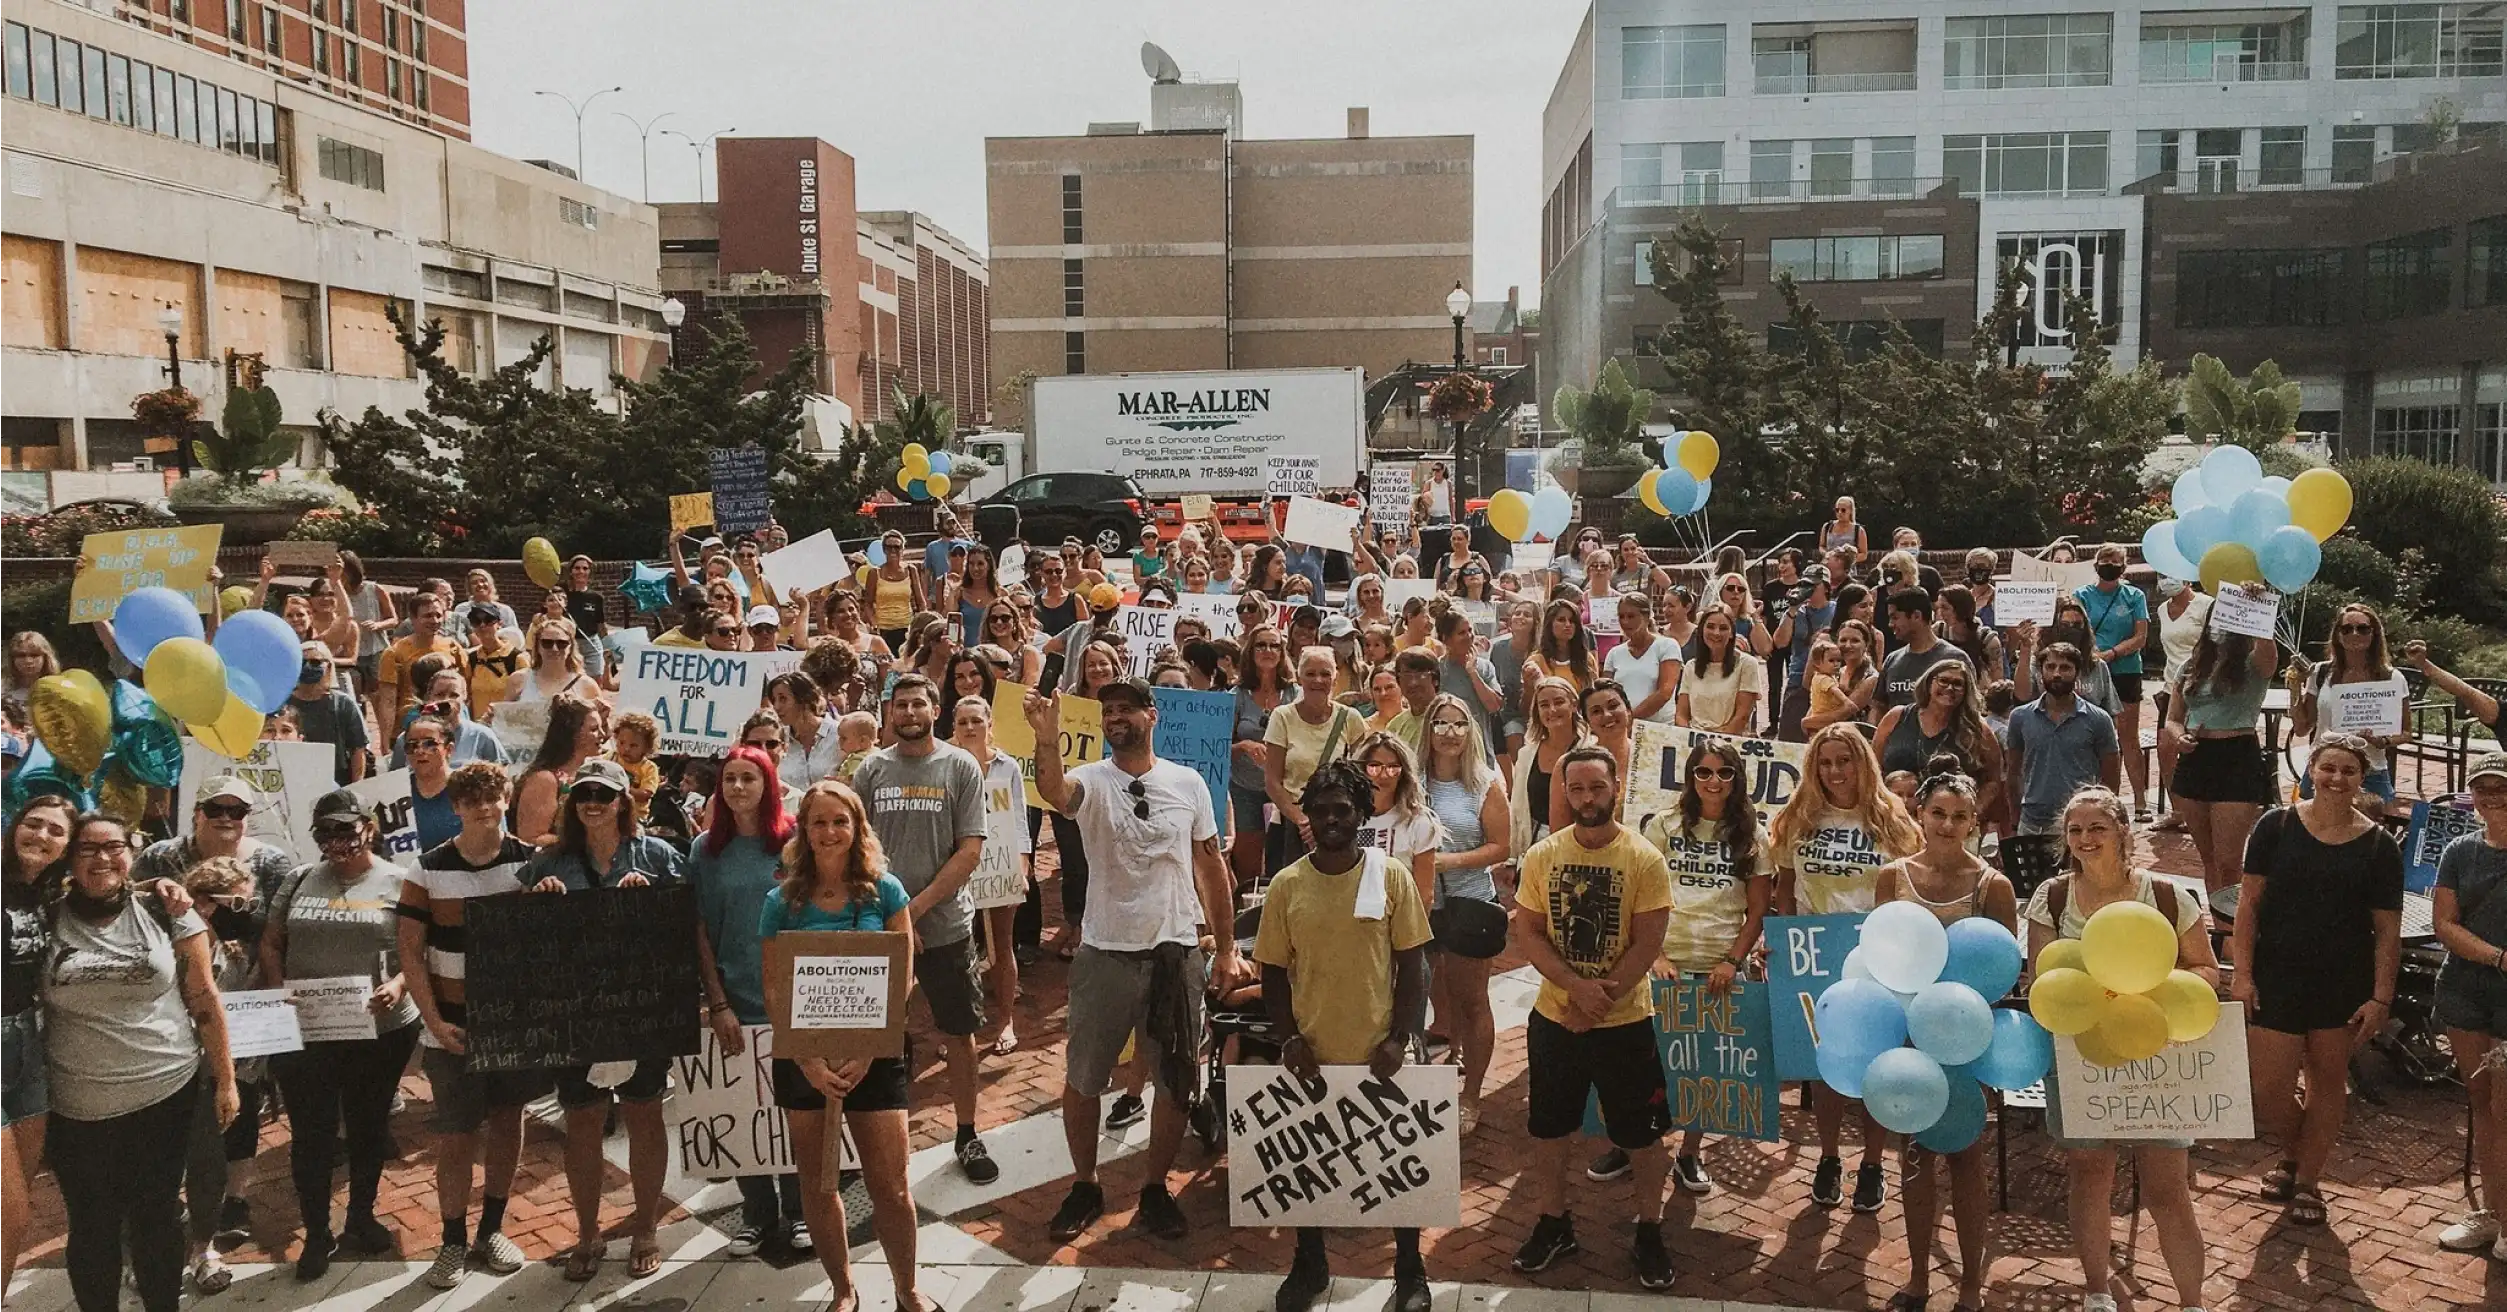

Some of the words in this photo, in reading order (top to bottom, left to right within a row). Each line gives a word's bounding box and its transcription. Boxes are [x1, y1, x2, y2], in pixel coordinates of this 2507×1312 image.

[799, 159, 817, 213] Garage
[800, 218, 817, 235] St
[801, 238, 818, 273] Duke
[1105, 436, 1141, 446] Gunite
[1145, 436, 1154, 444] &
[1159, 434, 1211, 445] Concrete
[1214, 433, 1286, 444] Construction
[1122, 447, 1157, 457] Bridge
[1160, 447, 1196, 456] Repair
[1203, 446, 1230, 455] Dam
[1233, 445, 1269, 454] Repair
[1267, 458, 1285, 468] KEEP
[1200, 466, 1259, 478] 717-859-4921
[1276, 469, 1293, 480] OFF
[1294, 469, 1314, 481] OUR
[1267, 480, 1319, 493] CHILDREN
[1371, 485, 1377, 493] A
[1371, 494, 1410, 505] MISSING
[1371, 511, 1409, 521] ABDUCTED
[96, 553, 145, 570] RISE
[169, 549, 199, 566] UP
[122, 570, 165, 589] FOR
[1997, 587, 2055, 595] ABOLITIONIST
[2221, 586, 2278, 606] ABOLITIONIST
[1212, 602, 1234, 618] the
[1126, 611, 1168, 638] RISE
[638, 650, 748, 687] FREEDOM
[680, 684, 706, 700] FOR
[2340, 689, 2397, 700] ABOLITIONIST
[1186, 697, 1232, 718] actions
[652, 696, 728, 739] ALL
[1160, 735, 1193, 756] ARE
[1200, 737, 1232, 760] NOT
[1740, 740, 1775, 757] get
[1660, 746, 1802, 805] LUD
[874, 798, 944, 814] TRAFFICKING
[1669, 836, 1718, 855] RISE
[1684, 852, 1700, 860] FOR
[1798, 846, 1882, 866] CHILDREN
[288, 908, 385, 925] TRAFFICKING
[1787, 926, 1830, 977] BE
[797, 966, 888, 976] ABOLITIONIST
[292, 986, 368, 998] ABOLITIONIST
[798, 984, 866, 996] CHILDREN
[807, 995, 840, 1005] NEED
[844, 996, 858, 1004] TO
[863, 995, 878, 1005] BE
[1668, 1034, 1699, 1072] all
[1713, 1036, 1758, 1078] the
[2178, 1050, 2216, 1081] UP
[2121, 1083, 2159, 1093] against
[1229, 1073, 1328, 1137] #END
[2086, 1094, 2183, 1122] SPEAK
[2193, 1093, 2233, 1122] UP
[1253, 1076, 1411, 1175] HUMAN
[2113, 1123, 2154, 1131] because
[680, 1114, 741, 1172] FOR
[1240, 1099, 1452, 1219] TRAFFICK-
[1350, 1154, 1430, 1215] ING
